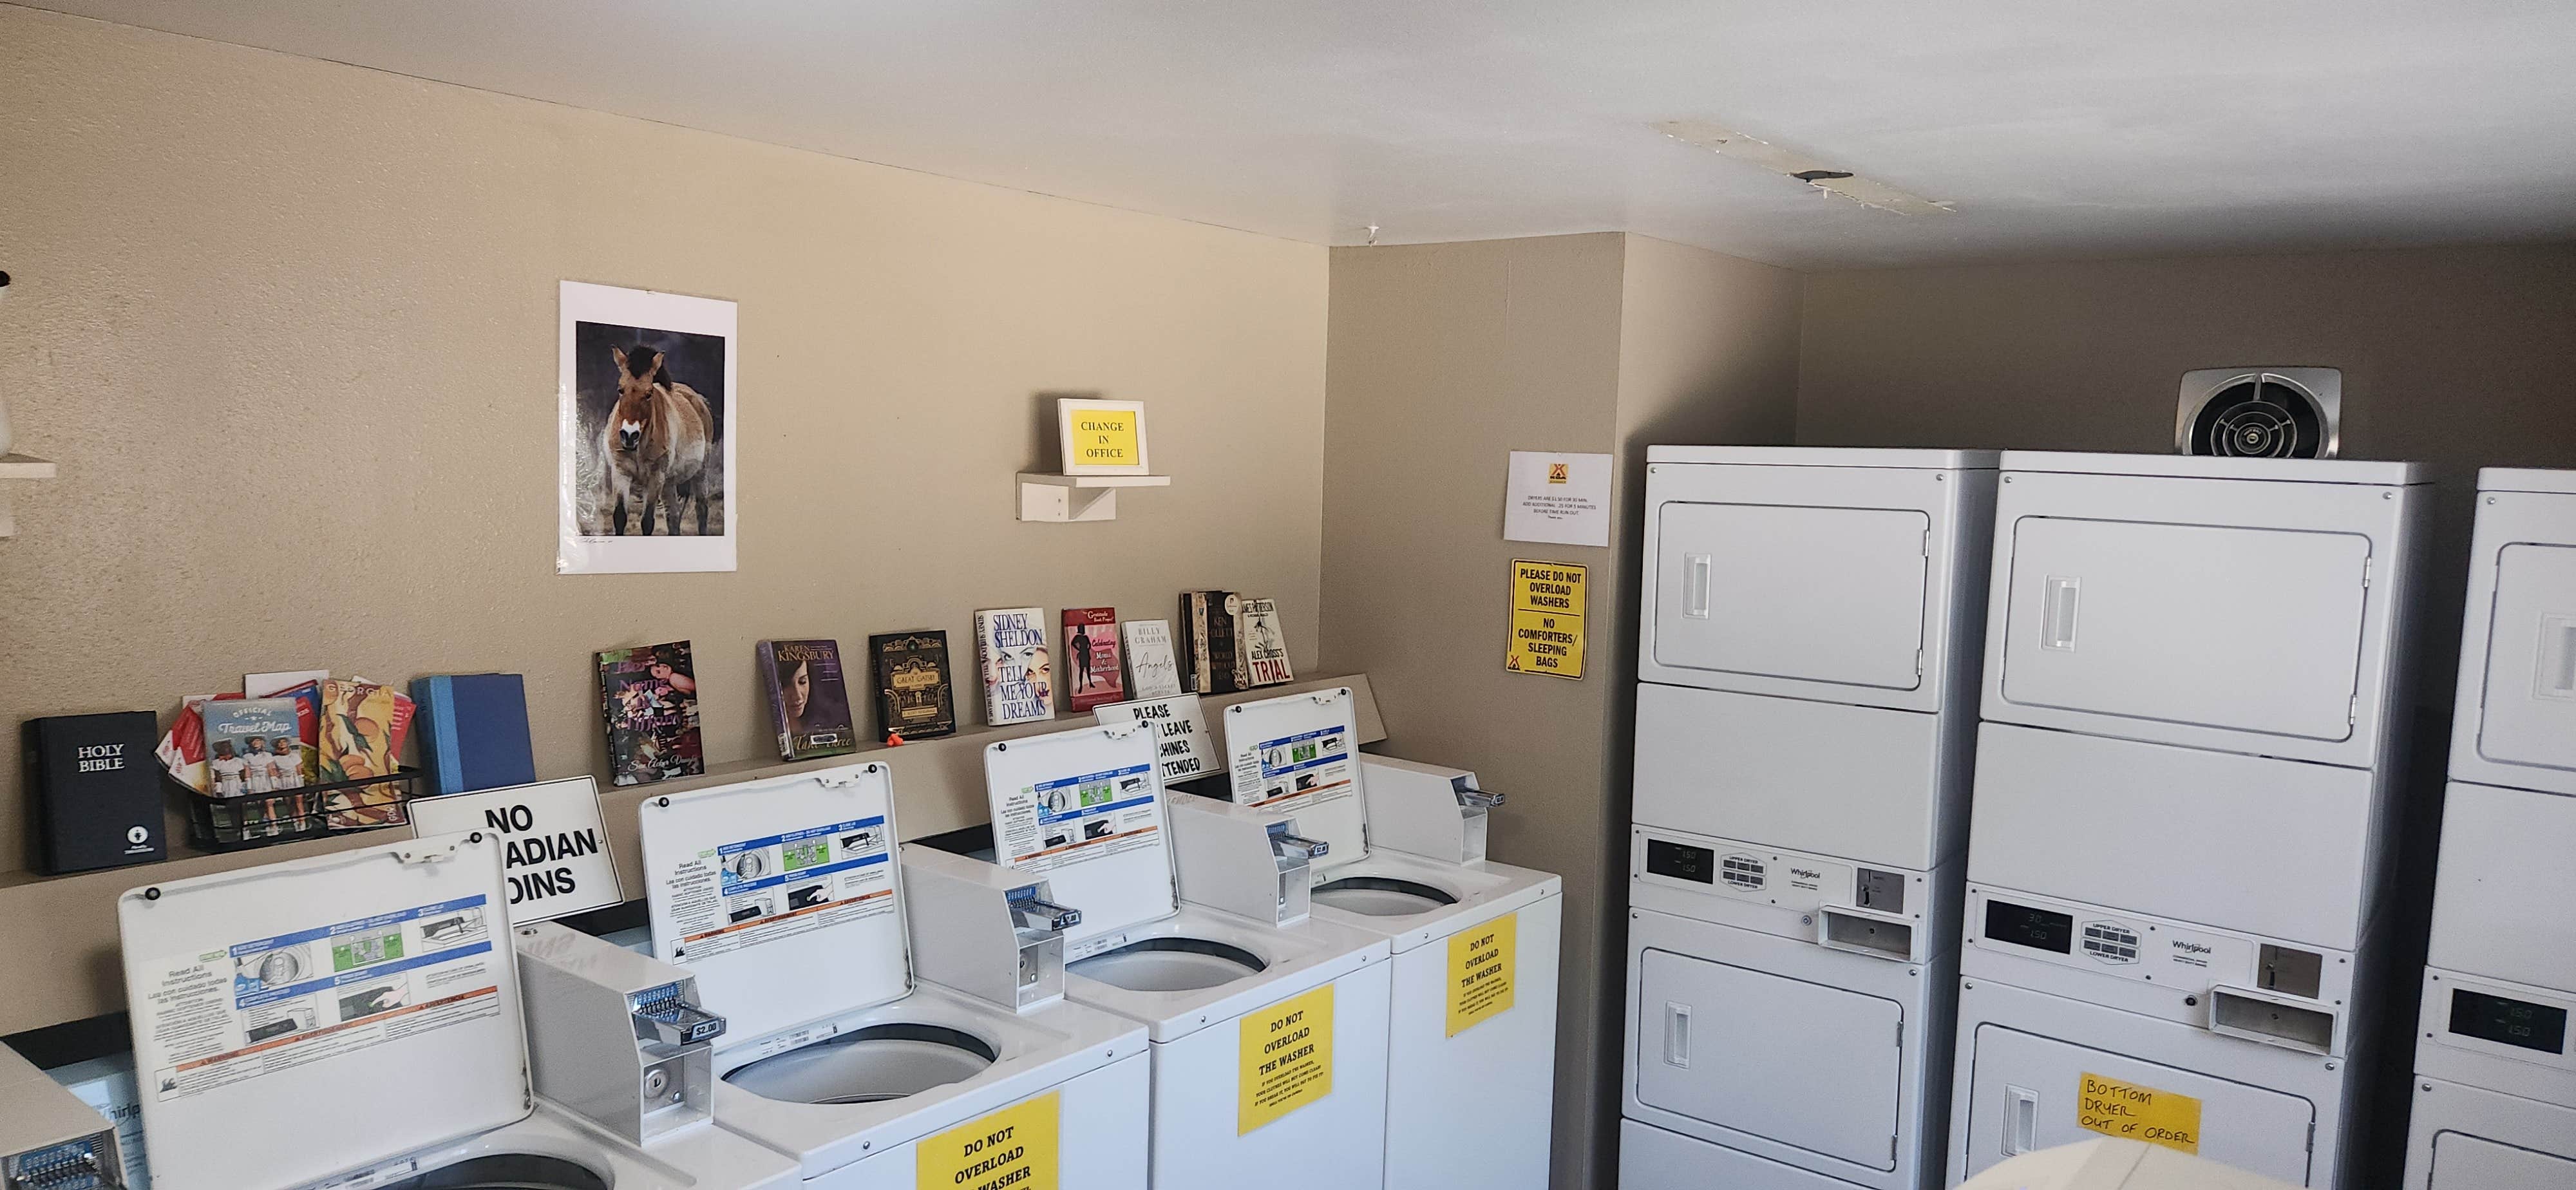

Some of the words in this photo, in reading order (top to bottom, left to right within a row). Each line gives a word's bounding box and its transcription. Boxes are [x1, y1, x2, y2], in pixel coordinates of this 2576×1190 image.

[1081, 422, 1124, 431] CHANGE
[1099, 435, 1109, 444] IN
[1086, 449, 1123, 458] OFFICE
[1520, 568, 1551, 580] PLEASE
[1553, 571, 1564, 581] DO
[1566, 572, 1581, 583] NOT
[1530, 582, 1571, 595] OVERLOAD
[1530, 595, 1569, 609] WASHERS
[993, 614, 1028, 631] SIDNEY
[1543, 618, 1555, 628] NO
[994, 629, 1043, 648] SHELDON
[1519, 628, 1578, 647] COMFORTERS/
[778, 650, 834, 662] KINGSBURY
[783, 645, 810, 654] KAREN
[1528, 643, 1567, 656] SLEEPING
[1135, 652, 1174, 678] Angels
[1536, 656, 1558, 668] BAGS
[998, 665, 1025, 683] TELL
[1253, 659, 1291, 682] TRIAL
[1001, 684, 1019, 701] ME
[1019, 681, 1050, 700] YOUR
[233, 707, 271, 718] OFFICIAL
[1002, 700, 1046, 719] DREAMS
[1133, 704, 1171, 720] PLEASE
[218, 722, 261, 734] Travel
[261, 721, 292, 733] Map
[1161, 719, 1193, 737] LEAVE
[78, 744, 124, 759] HOLY
[1160, 740, 1190, 757] HINES
[79, 758, 125, 772] BIBLE
[485, 805, 533, 833] NO
[506, 828, 598, 869] ADIAN
[1790, 868, 1820, 879] Whirlpool
[508, 867, 576, 905] OINS
[418, 908, 424, 916] 3
[330, 926, 337, 934] 2
[1470, 941, 1479, 952] DO
[1481, 934, 1494, 947] NOT
[2172, 940, 2211, 954] Whirlpool
[1465, 949, 1499, 970] OVERLOAD
[169, 968, 191, 978] Read
[192, 965, 204, 974] All
[1461, 975, 1474, 988] THE
[1476, 963, 1502, 981] WASHER
[334, 976, 340, 985] 5
[238, 998, 245, 1007] 4
[696, 1023, 717, 1035] $2.00
[1271, 1019, 1283, 1032] DO
[1285, 1010, 1303, 1026] NOT
[1264, 1027, 1310, 1054] OVERLOAD
[1259, 1059, 1276, 1076] THE
[1279, 1044, 1314, 1066] WASHER
[2087, 1079, 2152, 1105] BOTTOM
[2085, 1097, 2137, 1117] DRYER
[2081, 1115, 2114, 1129] OUT
[2121, 1123, 2138, 1133] OF
[2145, 1127, 2195, 1144] ORDER
[964, 1139, 983, 1157] DO
[987, 1126, 1014, 1148] NOT
[955, 1146, 1023, 1184] OVERLOAD
